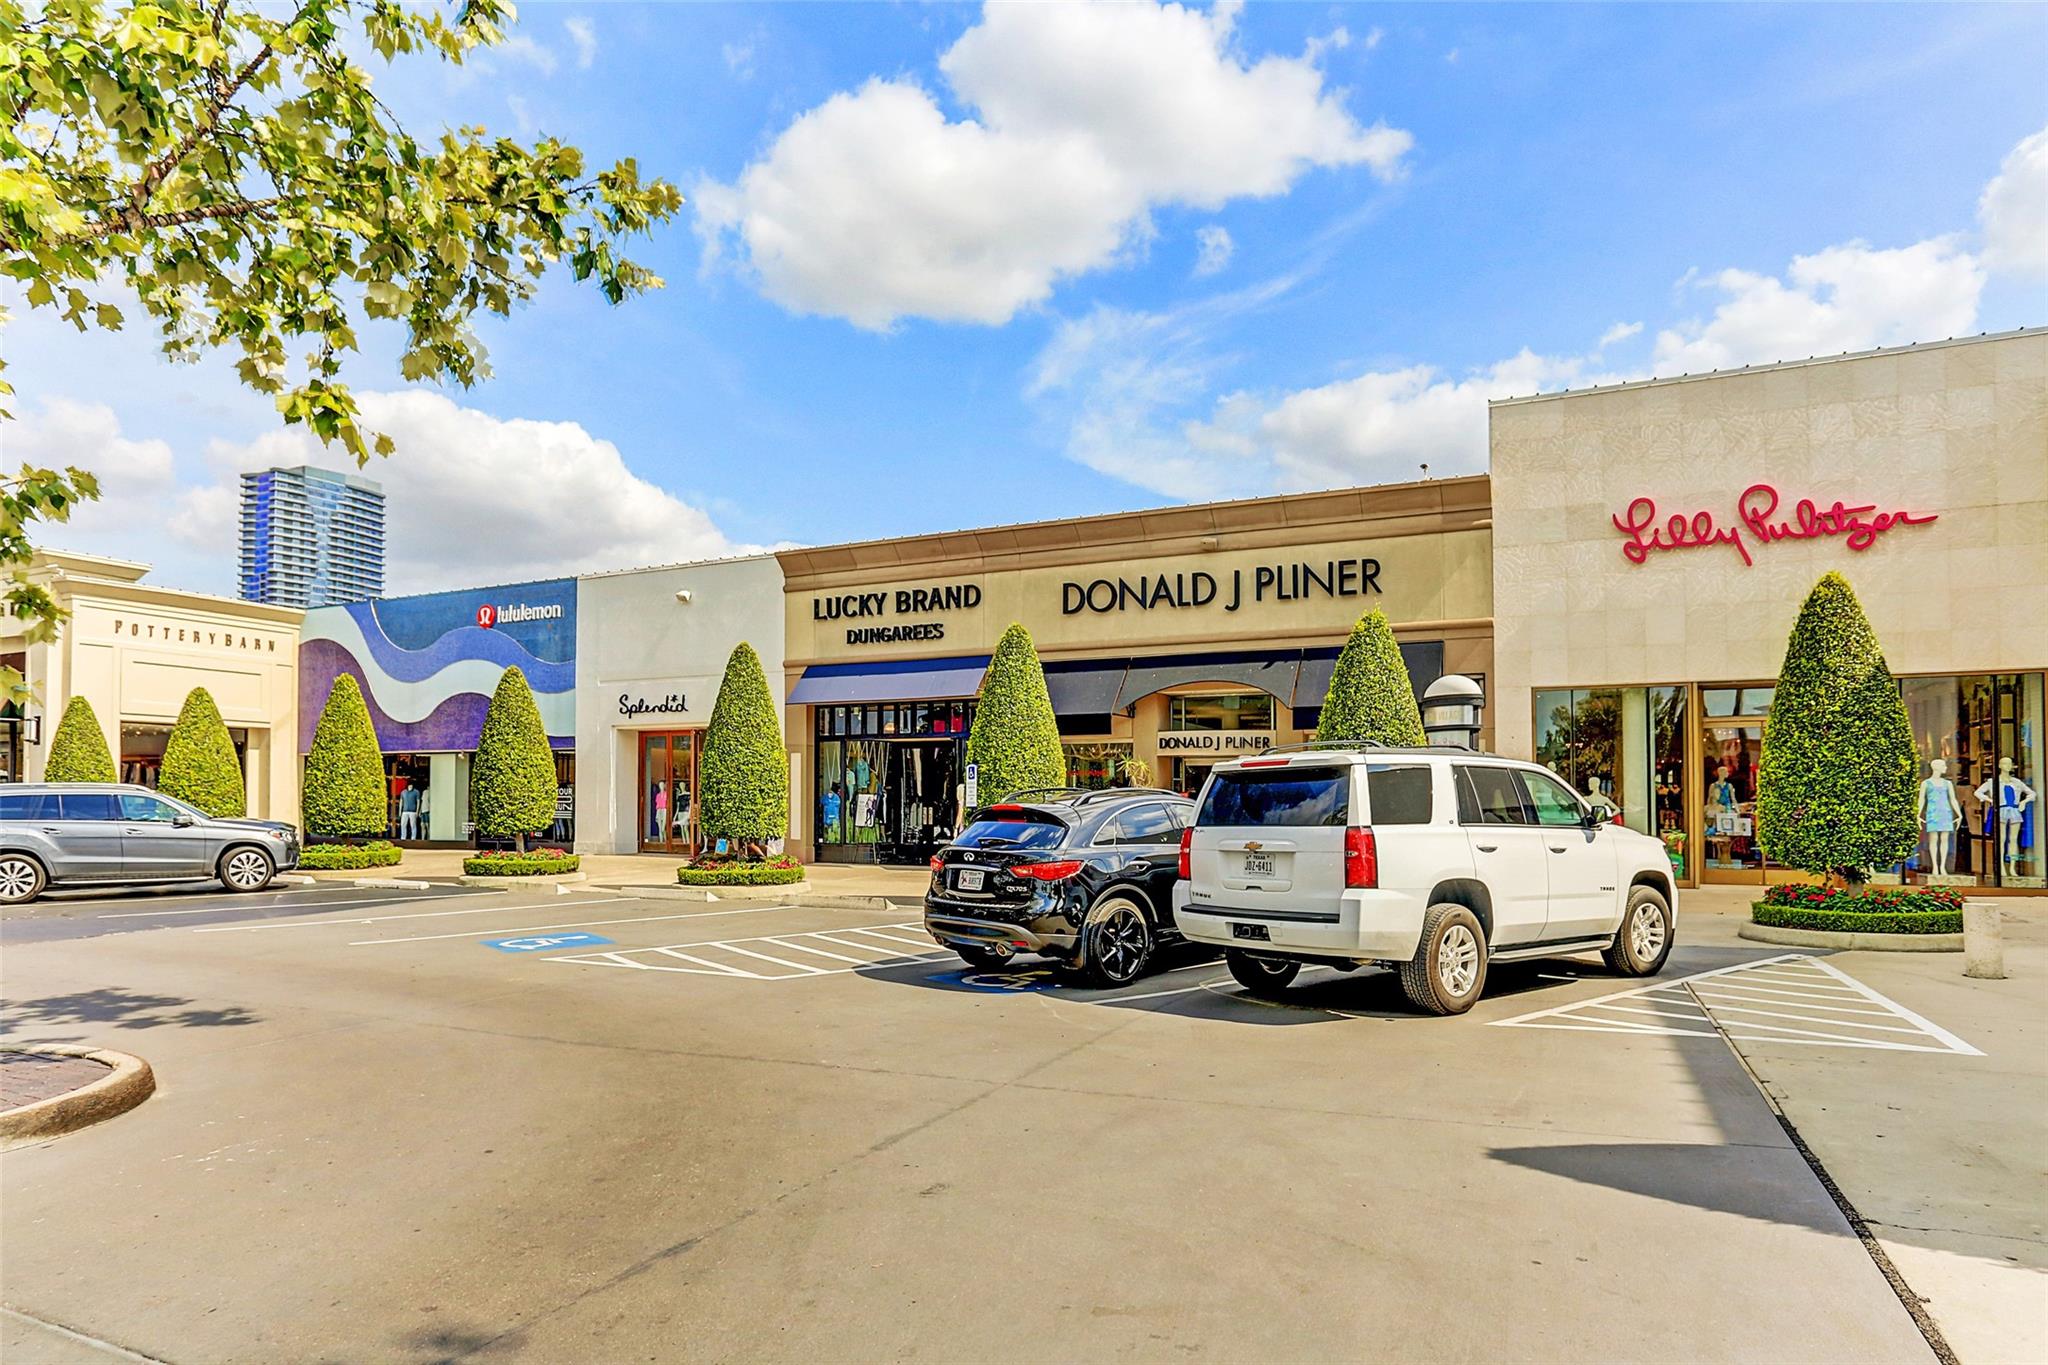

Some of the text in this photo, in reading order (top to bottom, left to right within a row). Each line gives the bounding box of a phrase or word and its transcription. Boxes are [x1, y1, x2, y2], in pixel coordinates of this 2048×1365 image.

[1612, 484, 1939, 567] Lilly Pulitzer
[1062, 558, 1383, 615] DONALD J PLINER
[497, 603, 562, 624] lululemon
[813, 584, 982, 621] LUCKY BRAND
[846, 623, 945, 645] DUNGAREES
[619, 694, 689, 719] Splendid
[1159, 735, 1271, 751] DONALD J PLINER
